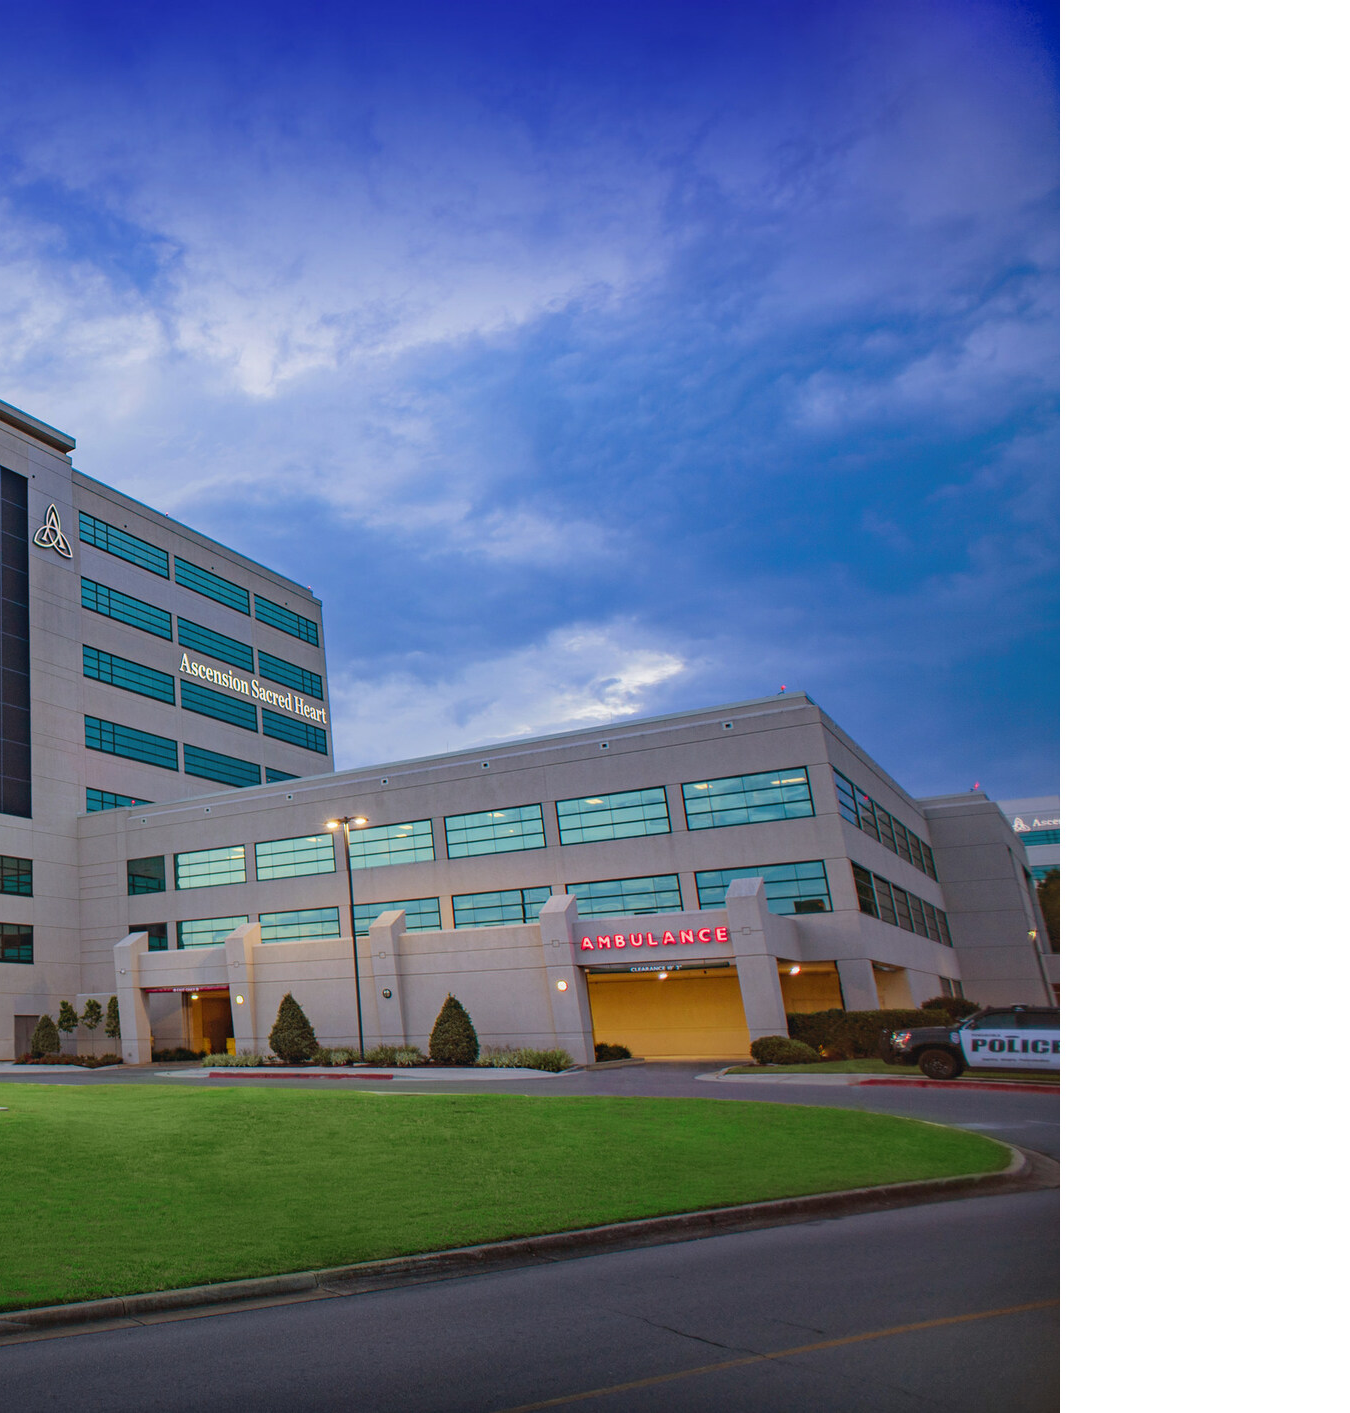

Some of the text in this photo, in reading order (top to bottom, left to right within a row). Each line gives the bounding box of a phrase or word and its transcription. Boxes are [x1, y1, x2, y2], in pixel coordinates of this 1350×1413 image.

[179, 652, 327, 724] Ascension Sacred Heart
[581, 926, 728, 950] AMBULANCE
